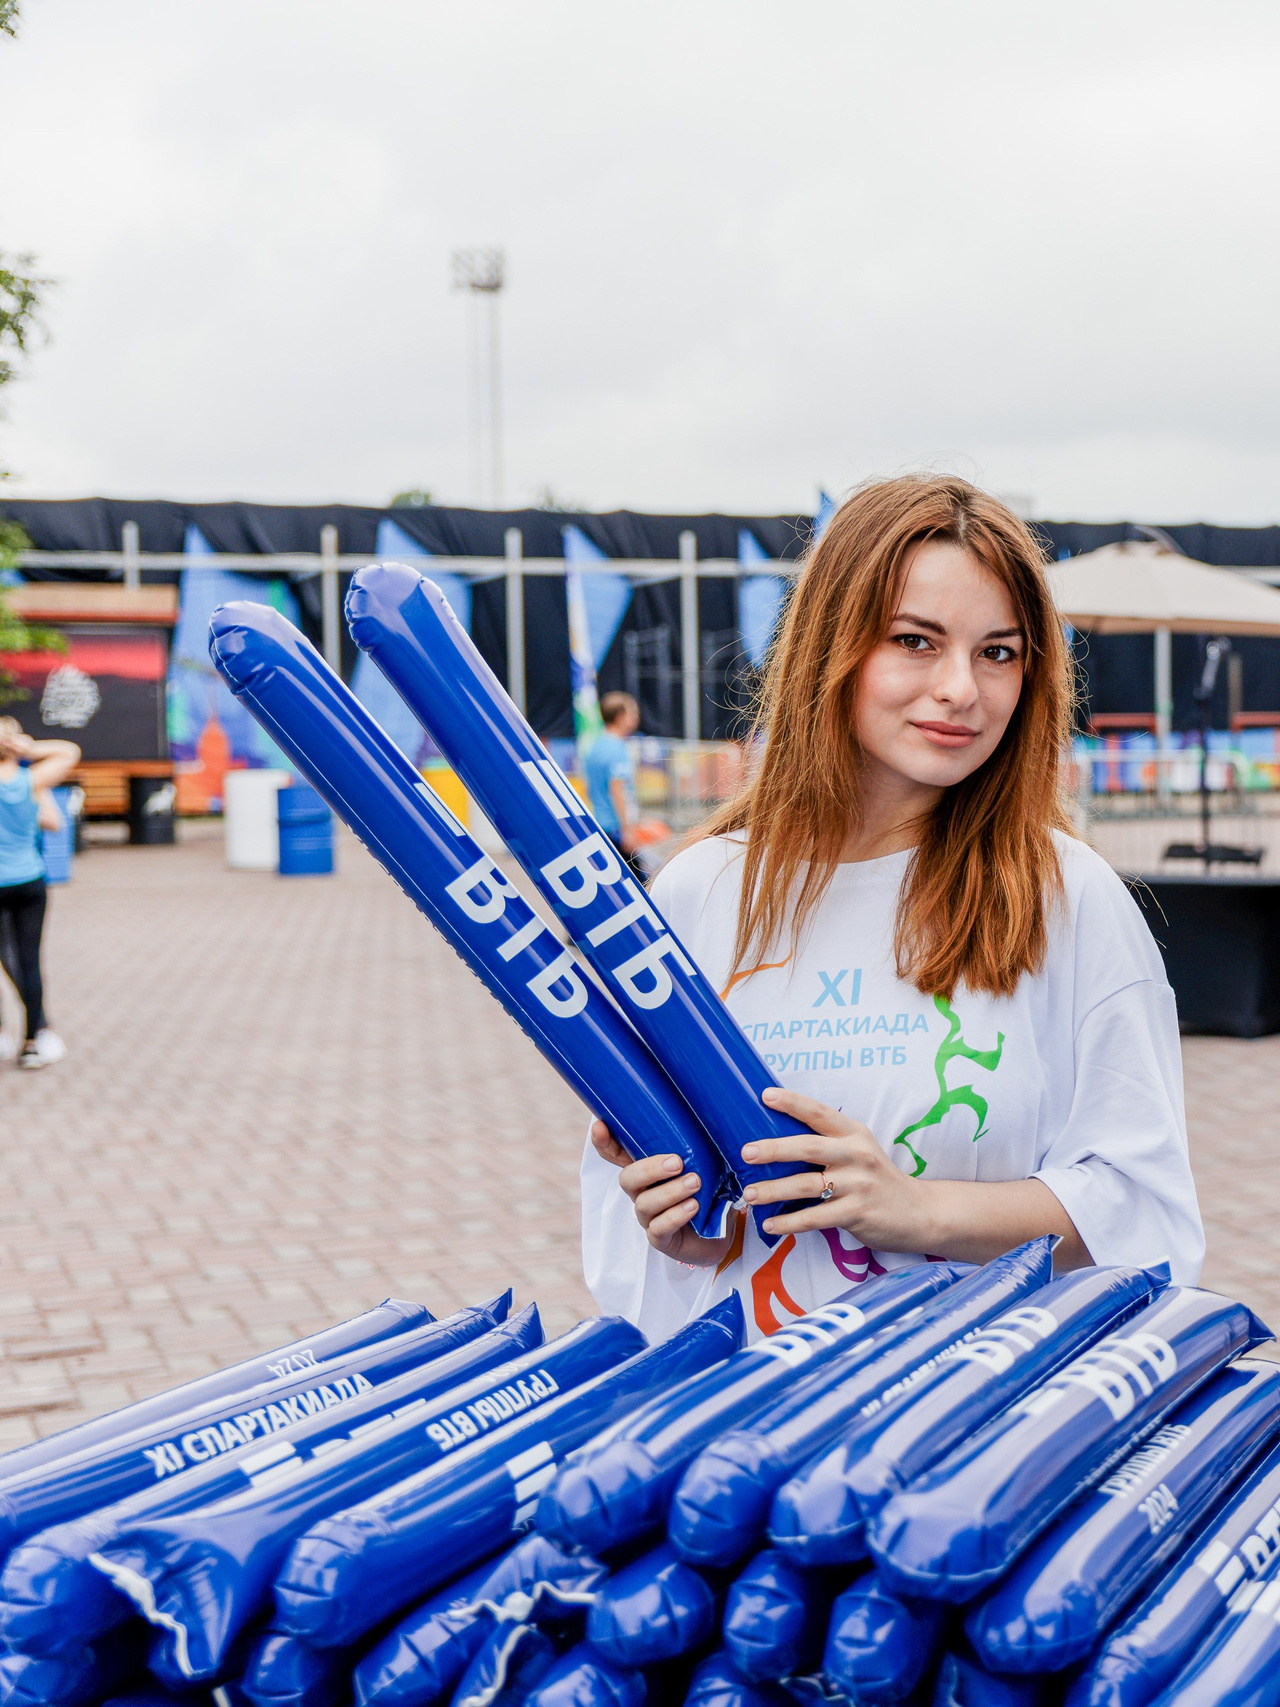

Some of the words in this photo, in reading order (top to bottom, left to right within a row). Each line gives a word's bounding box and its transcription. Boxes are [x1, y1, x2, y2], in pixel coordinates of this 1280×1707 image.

[540, 831, 697, 1010] ВТБ
[811, 969, 863, 1008] XI
[764, 1049, 851, 1073] РУППЫ
[859, 1045, 908, 1068] ВТБ
[142, 1442, 187, 1478] XI
[182, 1373, 375, 1462] СПАРТАКИАДА
[466, 1369, 560, 1430] ГРУППЫ
[425, 1410, 478, 1452] ВТБ
[1137, 1483, 1180, 1535] 2024
